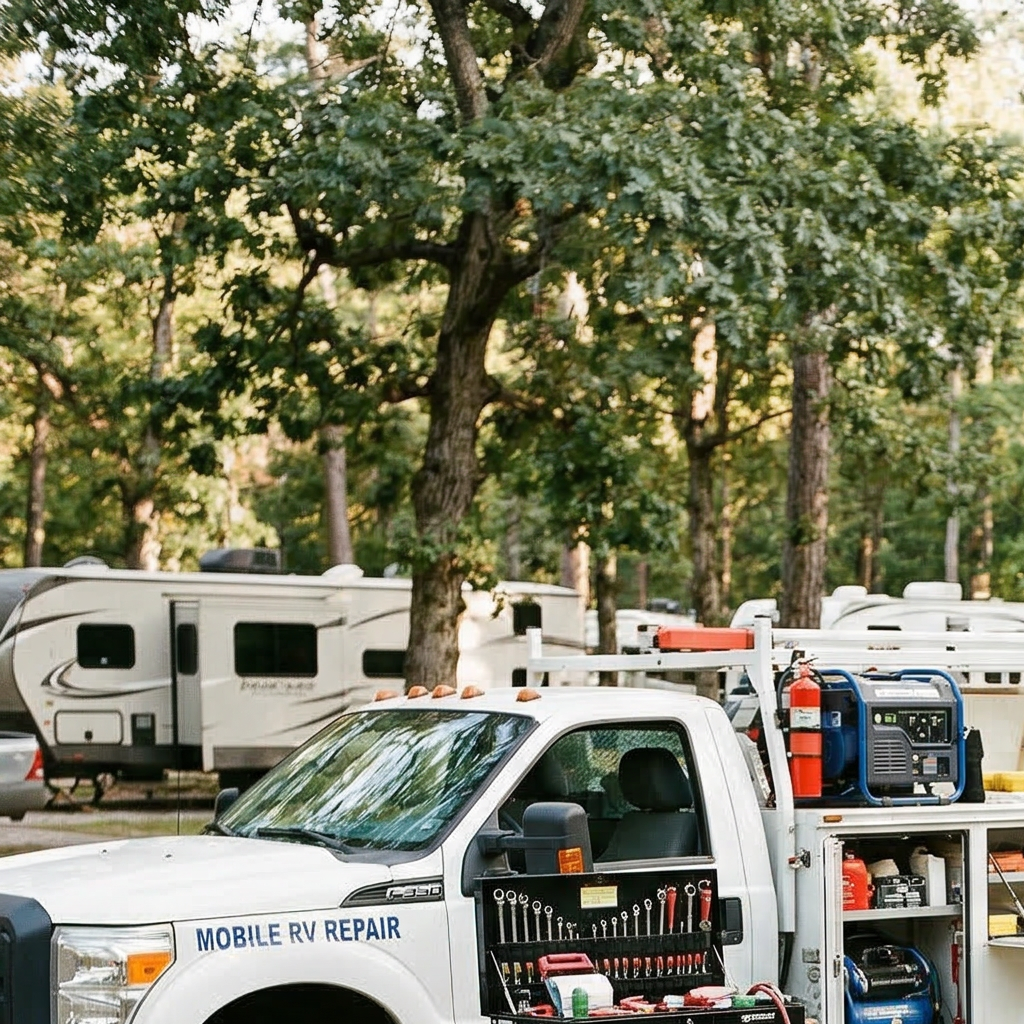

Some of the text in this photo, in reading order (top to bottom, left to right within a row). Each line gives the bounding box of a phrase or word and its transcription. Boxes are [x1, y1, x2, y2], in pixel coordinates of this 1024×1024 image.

[196, 916, 401, 951] MOBILE RV REPAIR
